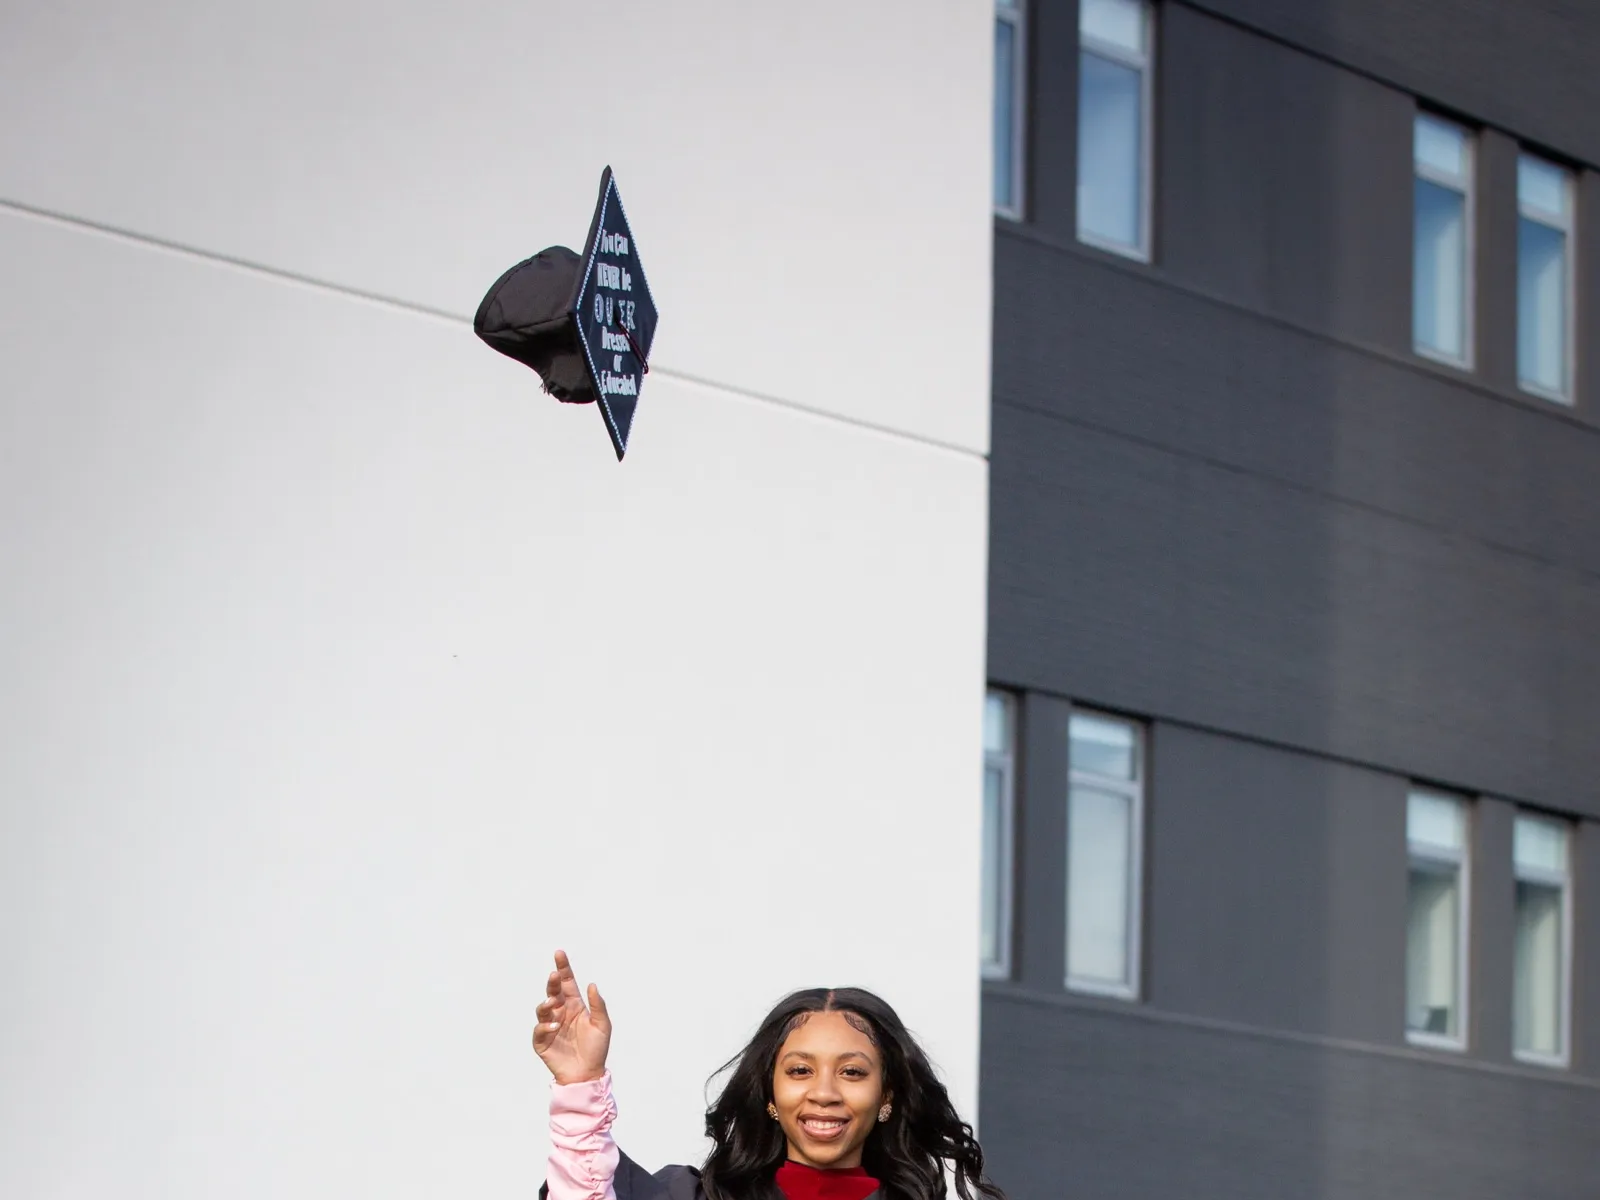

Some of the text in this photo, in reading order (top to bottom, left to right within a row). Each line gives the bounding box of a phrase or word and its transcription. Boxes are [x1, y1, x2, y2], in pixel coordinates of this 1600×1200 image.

[597, 262, 632, 292] NEVER be
[613, 354, 623, 373] or
[601, 371, 637, 396] Educated
